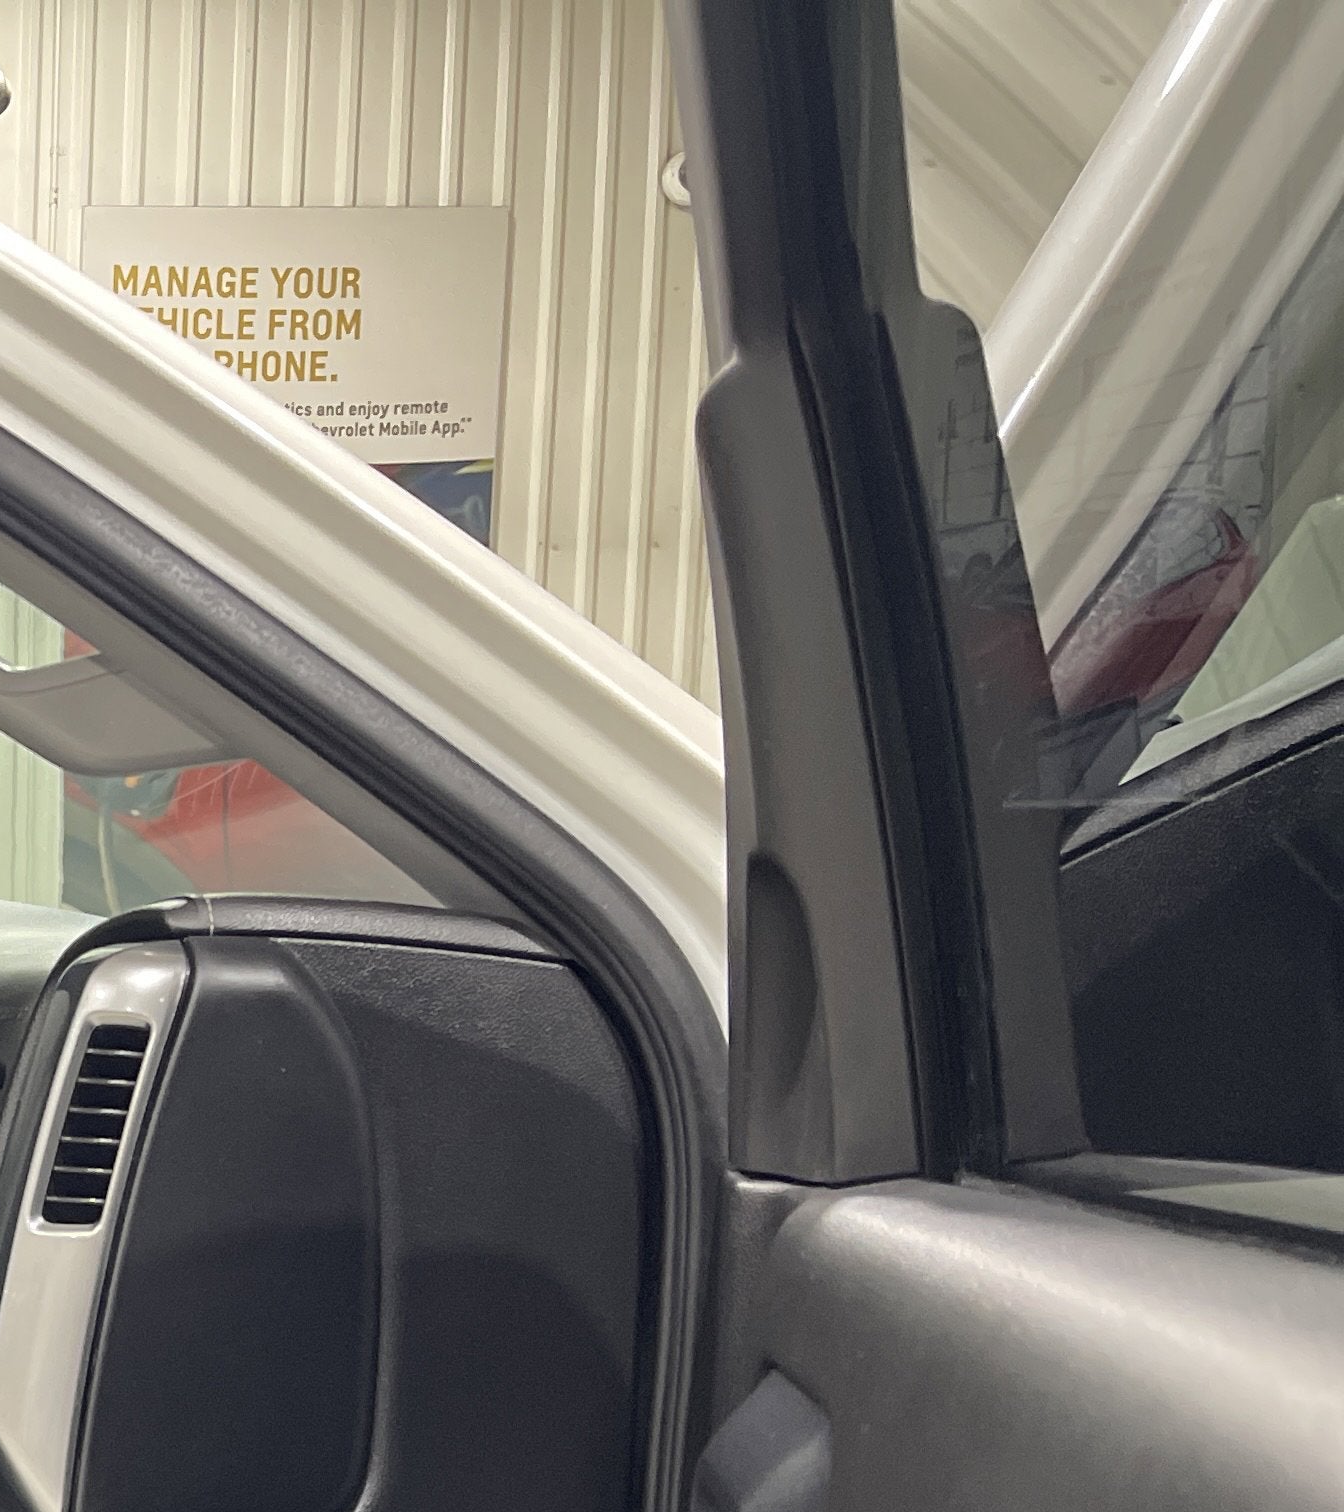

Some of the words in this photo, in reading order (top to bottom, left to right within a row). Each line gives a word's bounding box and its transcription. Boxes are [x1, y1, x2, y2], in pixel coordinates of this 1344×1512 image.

[112, 264, 259, 299] MANAGE
[270, 266, 361, 299] YOUR
[137, 307, 256, 340] HICLE
[268, 308, 362, 340] FROM
[317, 402, 344, 416] and
[349, 401, 389, 419] enjoy
[394, 401, 448, 415] remote
[379, 421, 427, 436] Mobile
